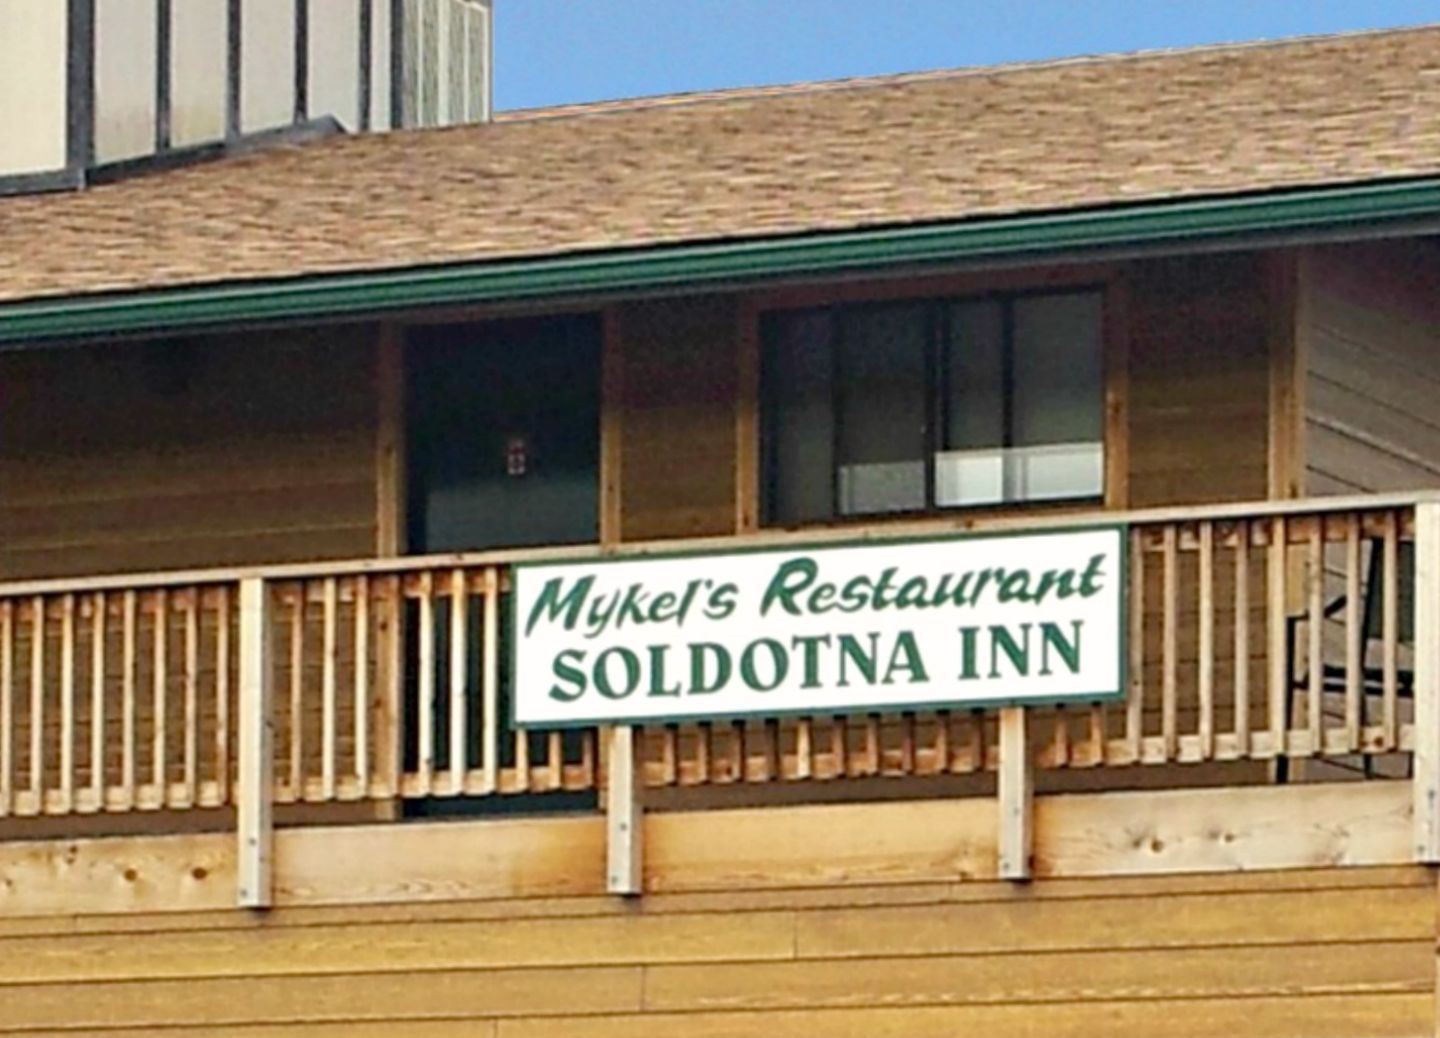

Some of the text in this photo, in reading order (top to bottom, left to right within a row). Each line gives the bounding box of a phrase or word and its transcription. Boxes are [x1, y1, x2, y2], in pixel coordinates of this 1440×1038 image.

[525, 553, 1107, 639] Mykel's Restaurant
[547, 620, 1084, 702] SOLDOTNA INN
